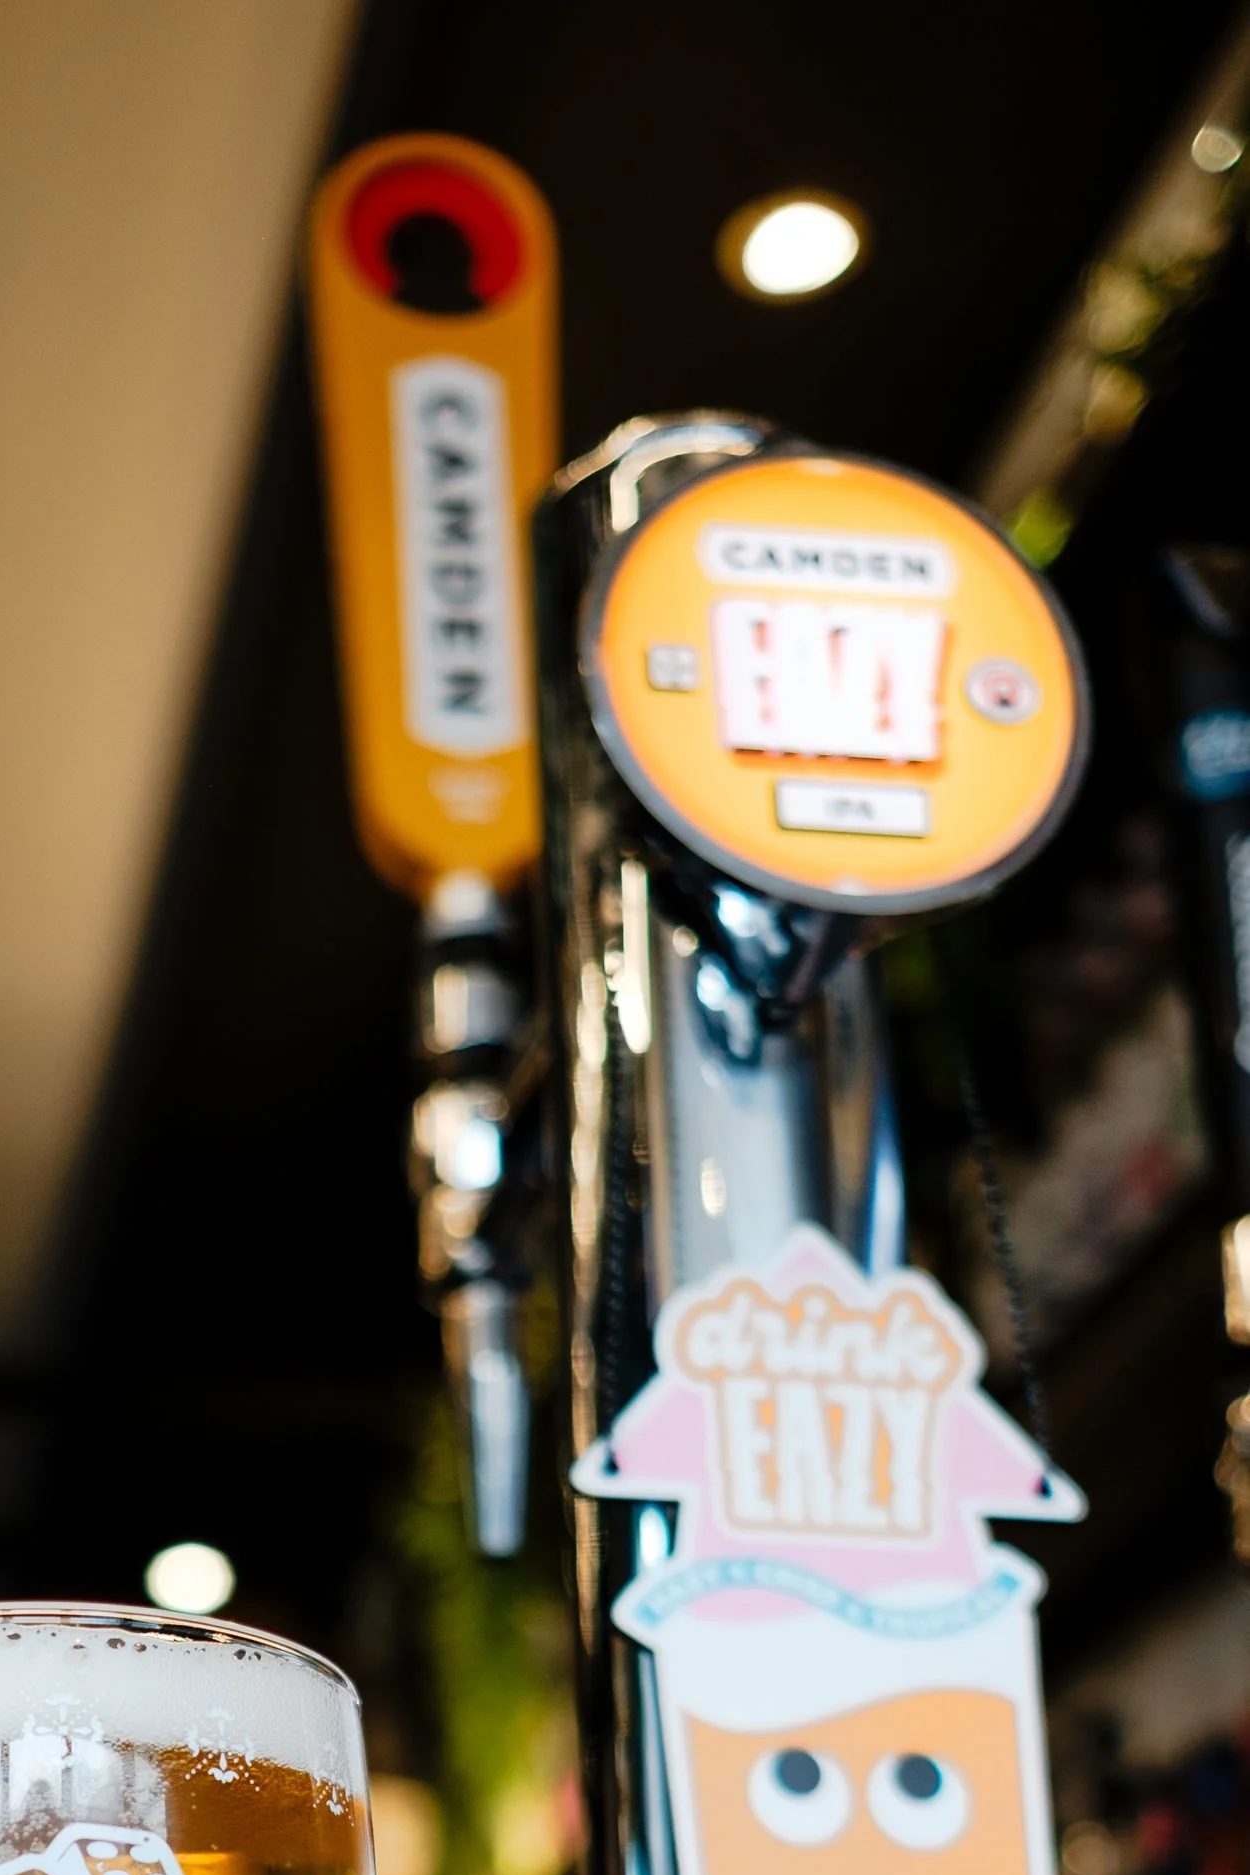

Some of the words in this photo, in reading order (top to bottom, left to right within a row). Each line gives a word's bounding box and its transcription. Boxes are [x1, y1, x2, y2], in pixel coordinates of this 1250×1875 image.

[419, 390, 487, 717] CAMDEN
[720, 540, 936, 584] CAMDEN
[685, 1295, 948, 1386] drink
[722, 1378, 932, 1530] EAZY
